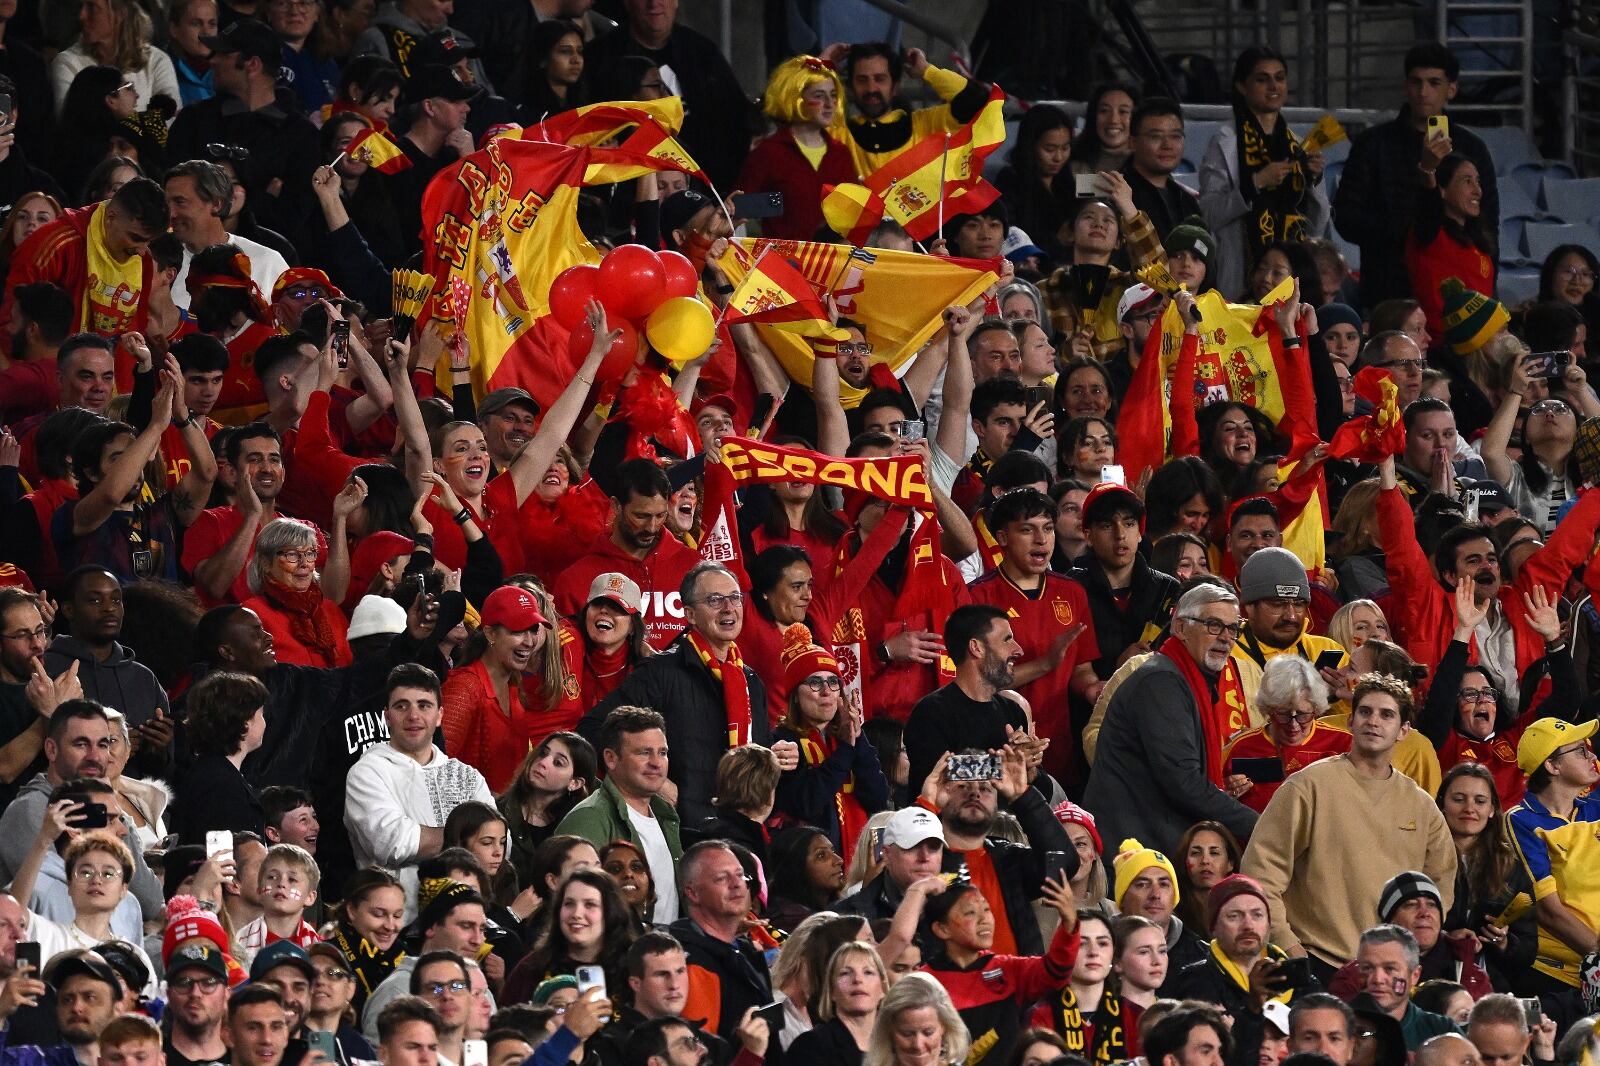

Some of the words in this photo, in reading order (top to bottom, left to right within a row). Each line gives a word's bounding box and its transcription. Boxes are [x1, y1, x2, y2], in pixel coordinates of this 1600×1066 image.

[640, 591, 685, 619] VIC
[645, 621, 654, 630] of
[656, 621, 686, 631] Victoria
[344, 710, 391, 755] CHAM
[1061, 986, 1084, 1050] 023
